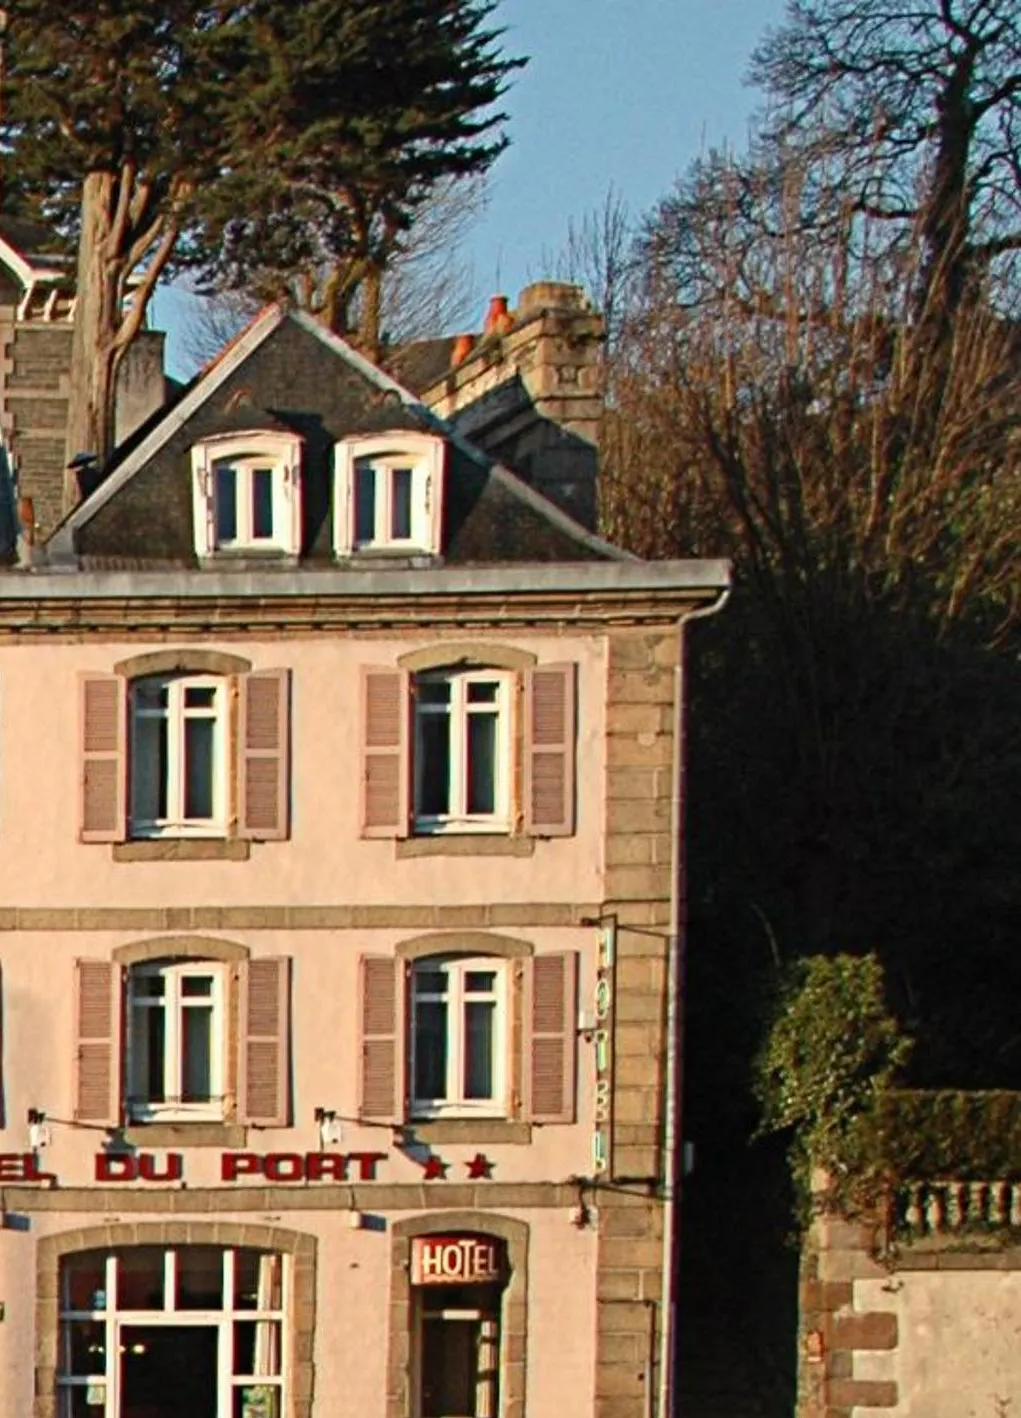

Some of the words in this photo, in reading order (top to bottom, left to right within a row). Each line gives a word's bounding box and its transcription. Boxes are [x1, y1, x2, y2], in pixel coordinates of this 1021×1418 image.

[95, 1152, 182, 1181] DU
[221, 1152, 384, 1181] PORT
[422, 1240, 498, 1279] HOTEL
